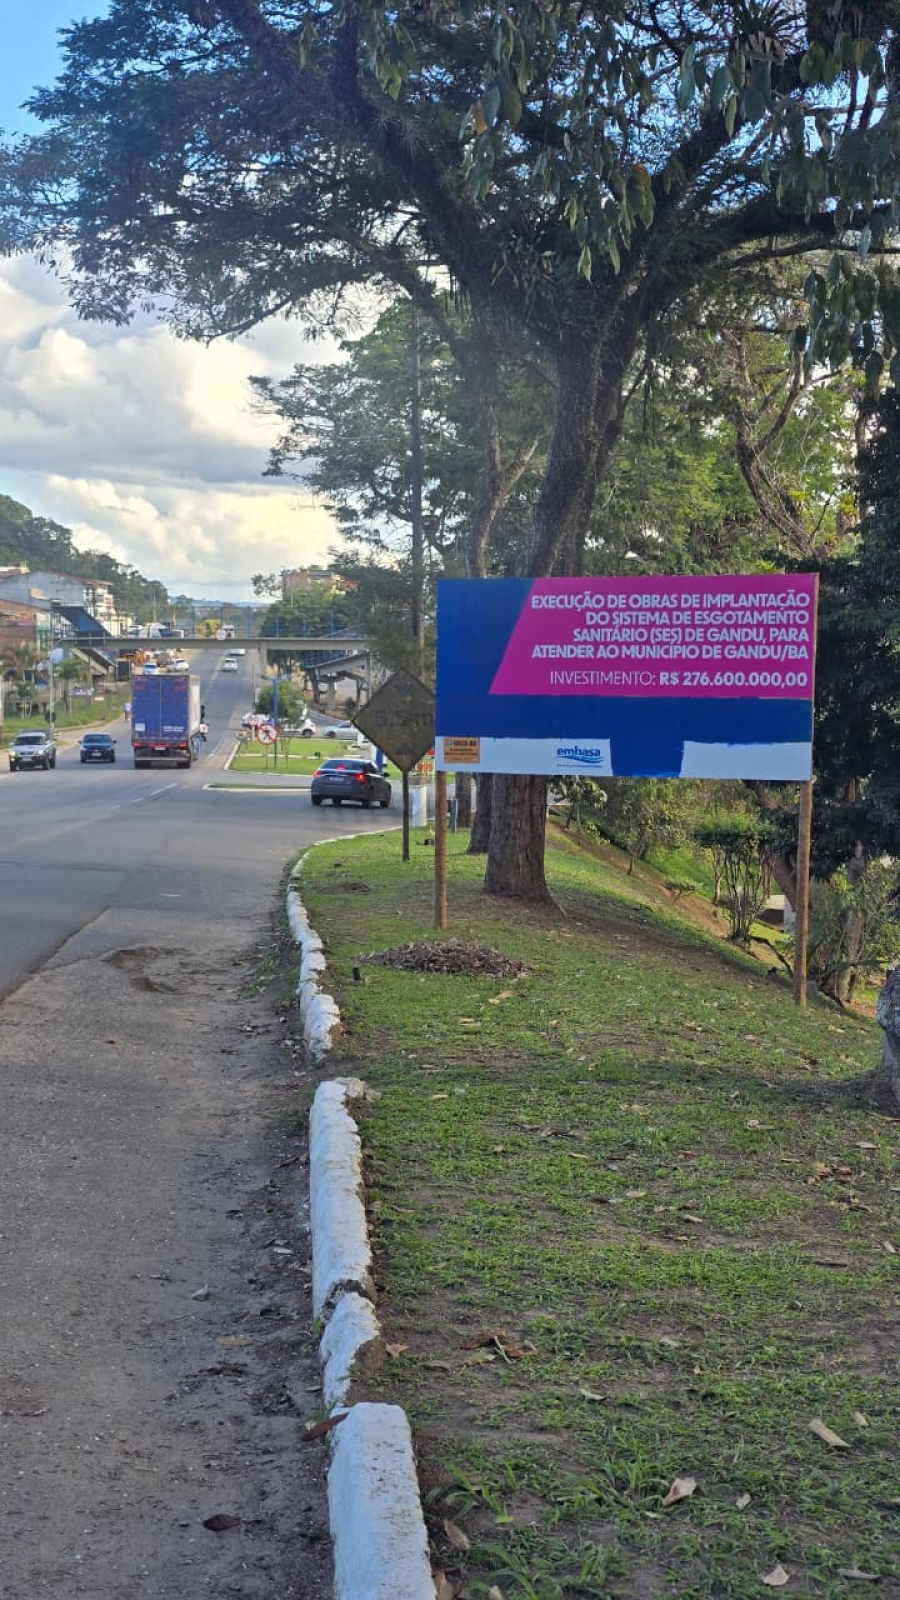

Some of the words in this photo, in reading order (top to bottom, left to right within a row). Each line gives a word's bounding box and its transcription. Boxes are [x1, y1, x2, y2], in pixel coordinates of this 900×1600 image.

[531, 590, 605, 612] EXECUÇÃO
[607, 594, 627, 608] DE
[628, 594, 678, 608] OBRAS
[681, 593, 700, 608] DE
[703, 589, 811, 611] IMPLANTAÇÃO
[586, 611, 610, 625] DO
[612, 611, 670, 625] SISTEMA
[672, 611, 692, 625] DE
[694, 610, 810, 625] ESGOTAMENTO
[573, 624, 648, 642] SANITÁRIO
[650, 628, 681, 644] (SES)
[685, 628, 704, 641] DE
[707, 628, 766, 645] GANDU,
[769, 628, 809, 642] PARA
[531, 644, 595, 659] ATENDER
[596, 644, 619, 659] AO
[621, 640, 699, 659] MUNICÍPIO
[702, 645, 722, 659] DE
[724, 644, 809, 662] GANDU/BA
[550, 670, 656, 686] INVESTIMENTO:
[659, 671, 680, 688] R$
[683, 672, 807, 689] 276.600.000,00
[557, 745, 601, 757] embasa
